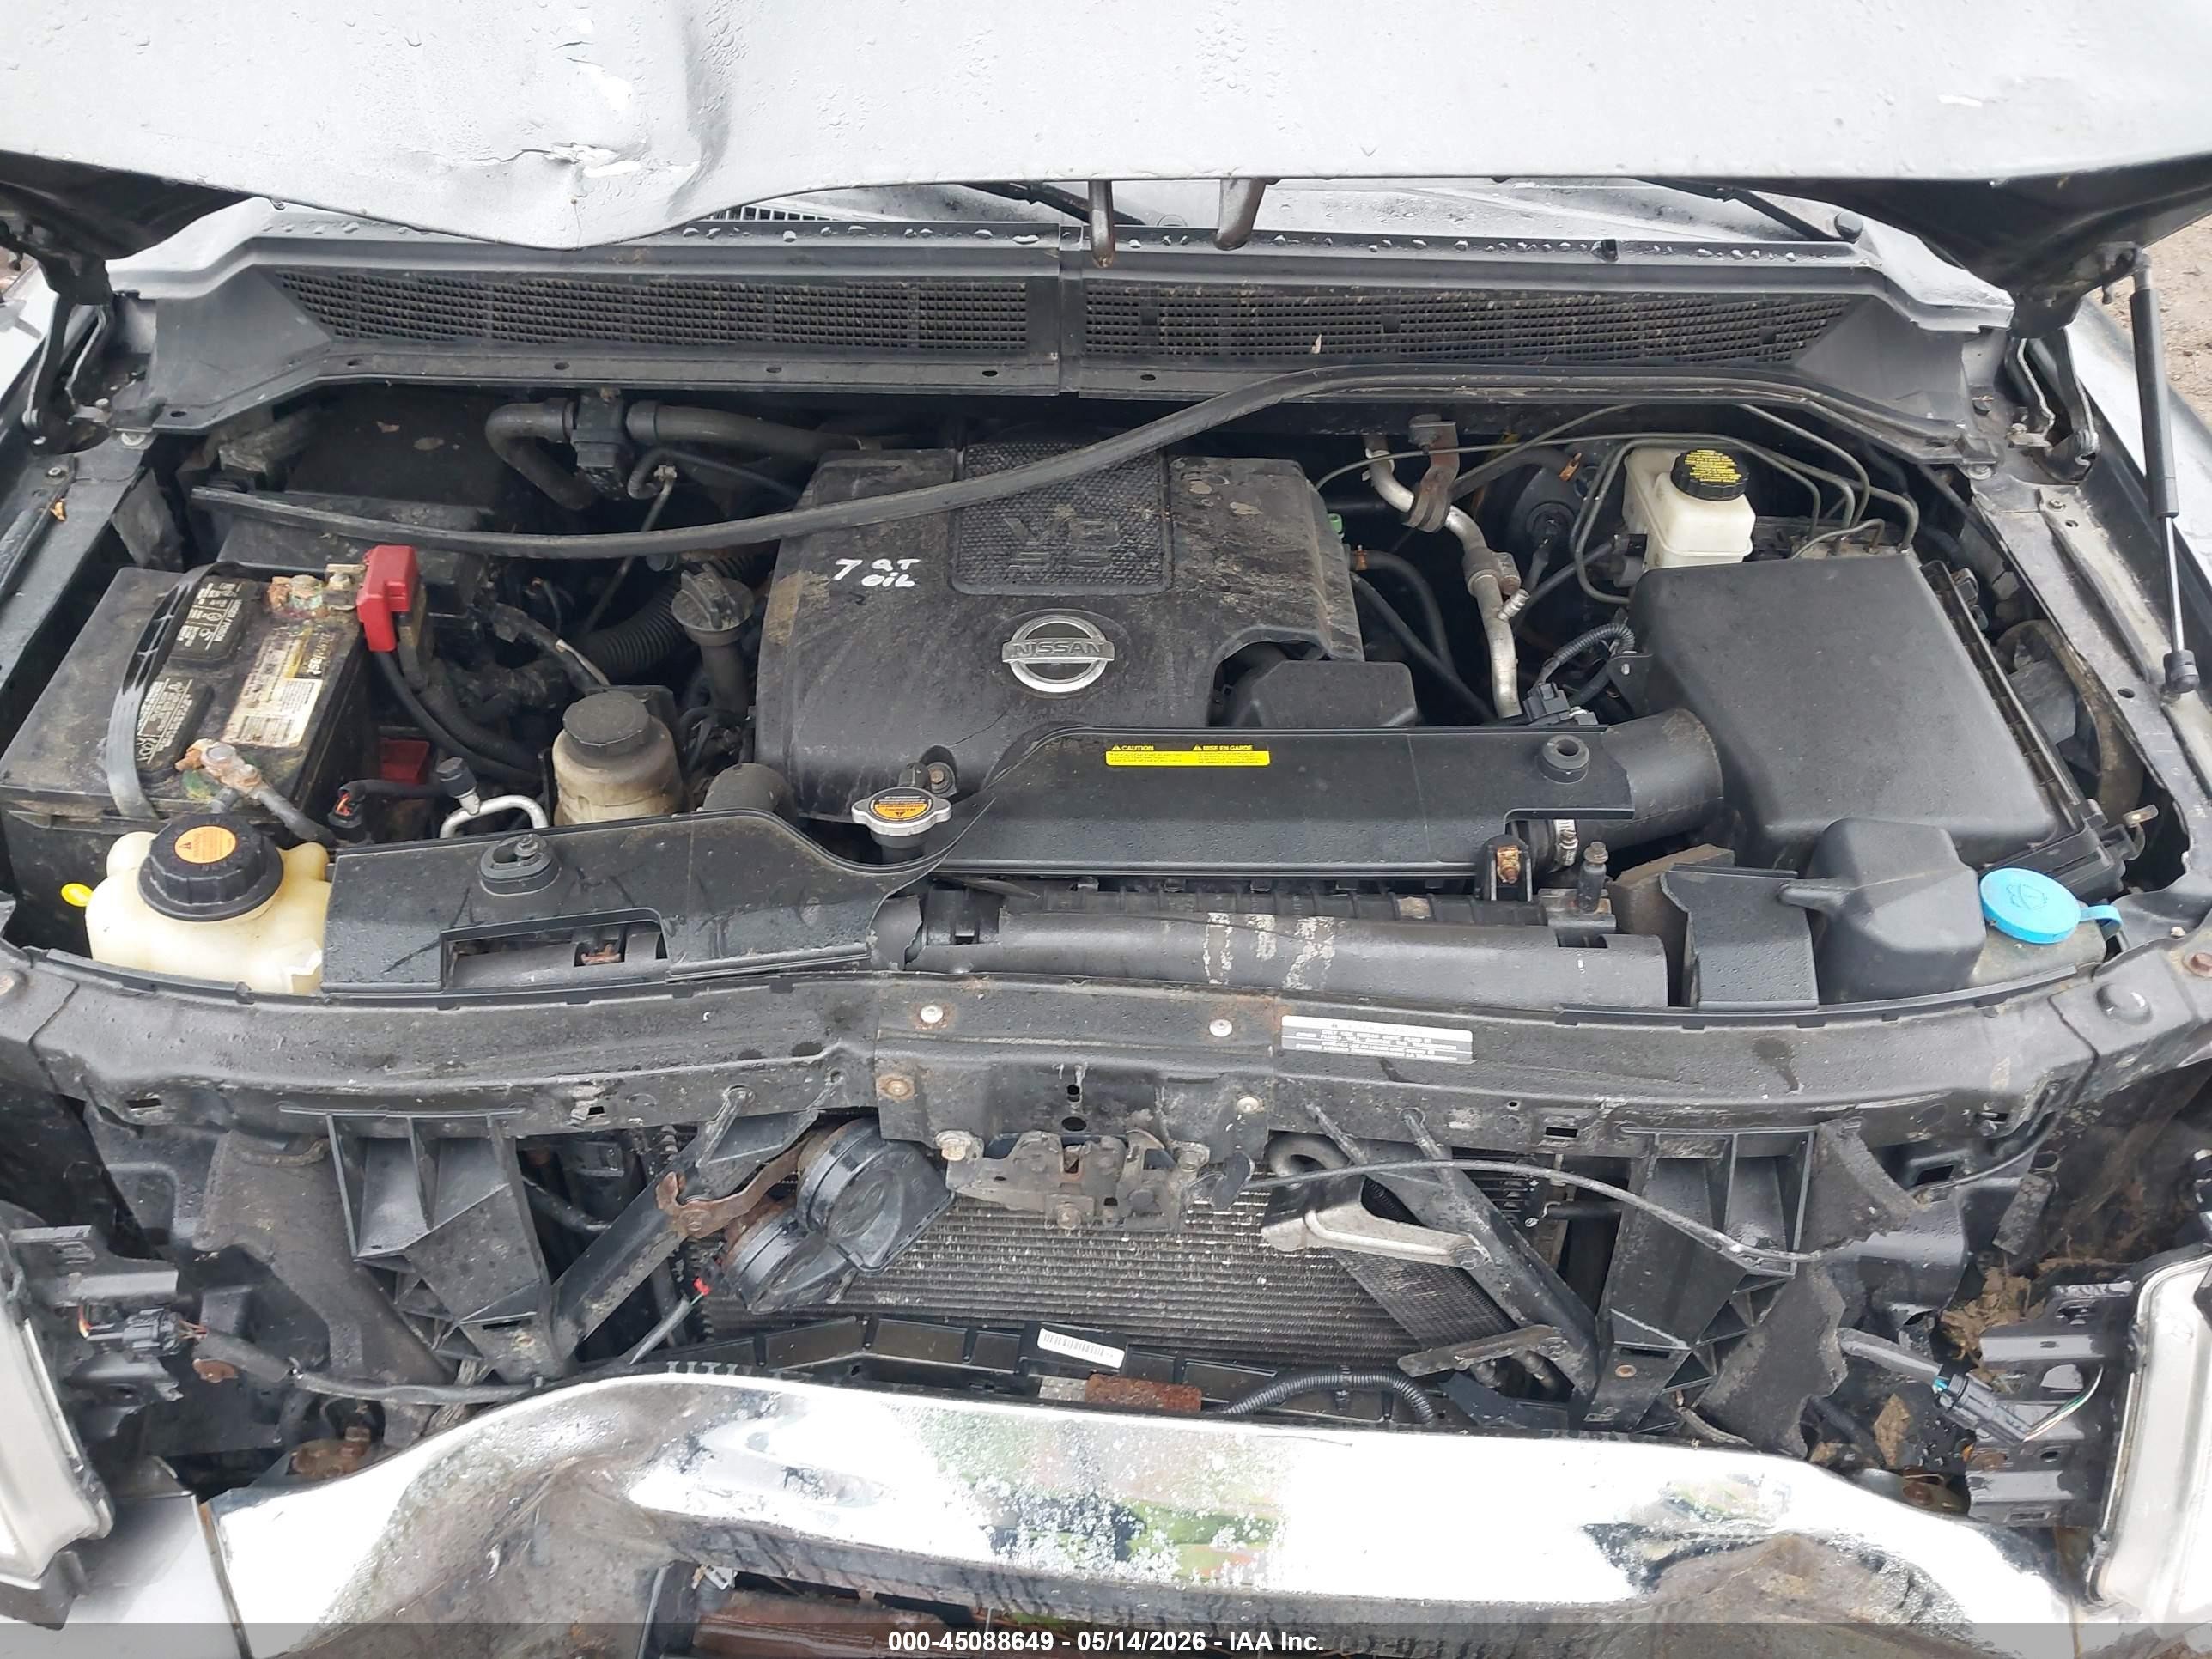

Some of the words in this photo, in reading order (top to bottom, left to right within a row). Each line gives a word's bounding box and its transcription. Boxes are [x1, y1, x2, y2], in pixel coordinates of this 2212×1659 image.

[1002, 516, 1118, 547] V8
[833, 558, 863, 581] 7
[872, 558, 921, 572] QT
[1012, 641, 1104, 657] NISSAN
